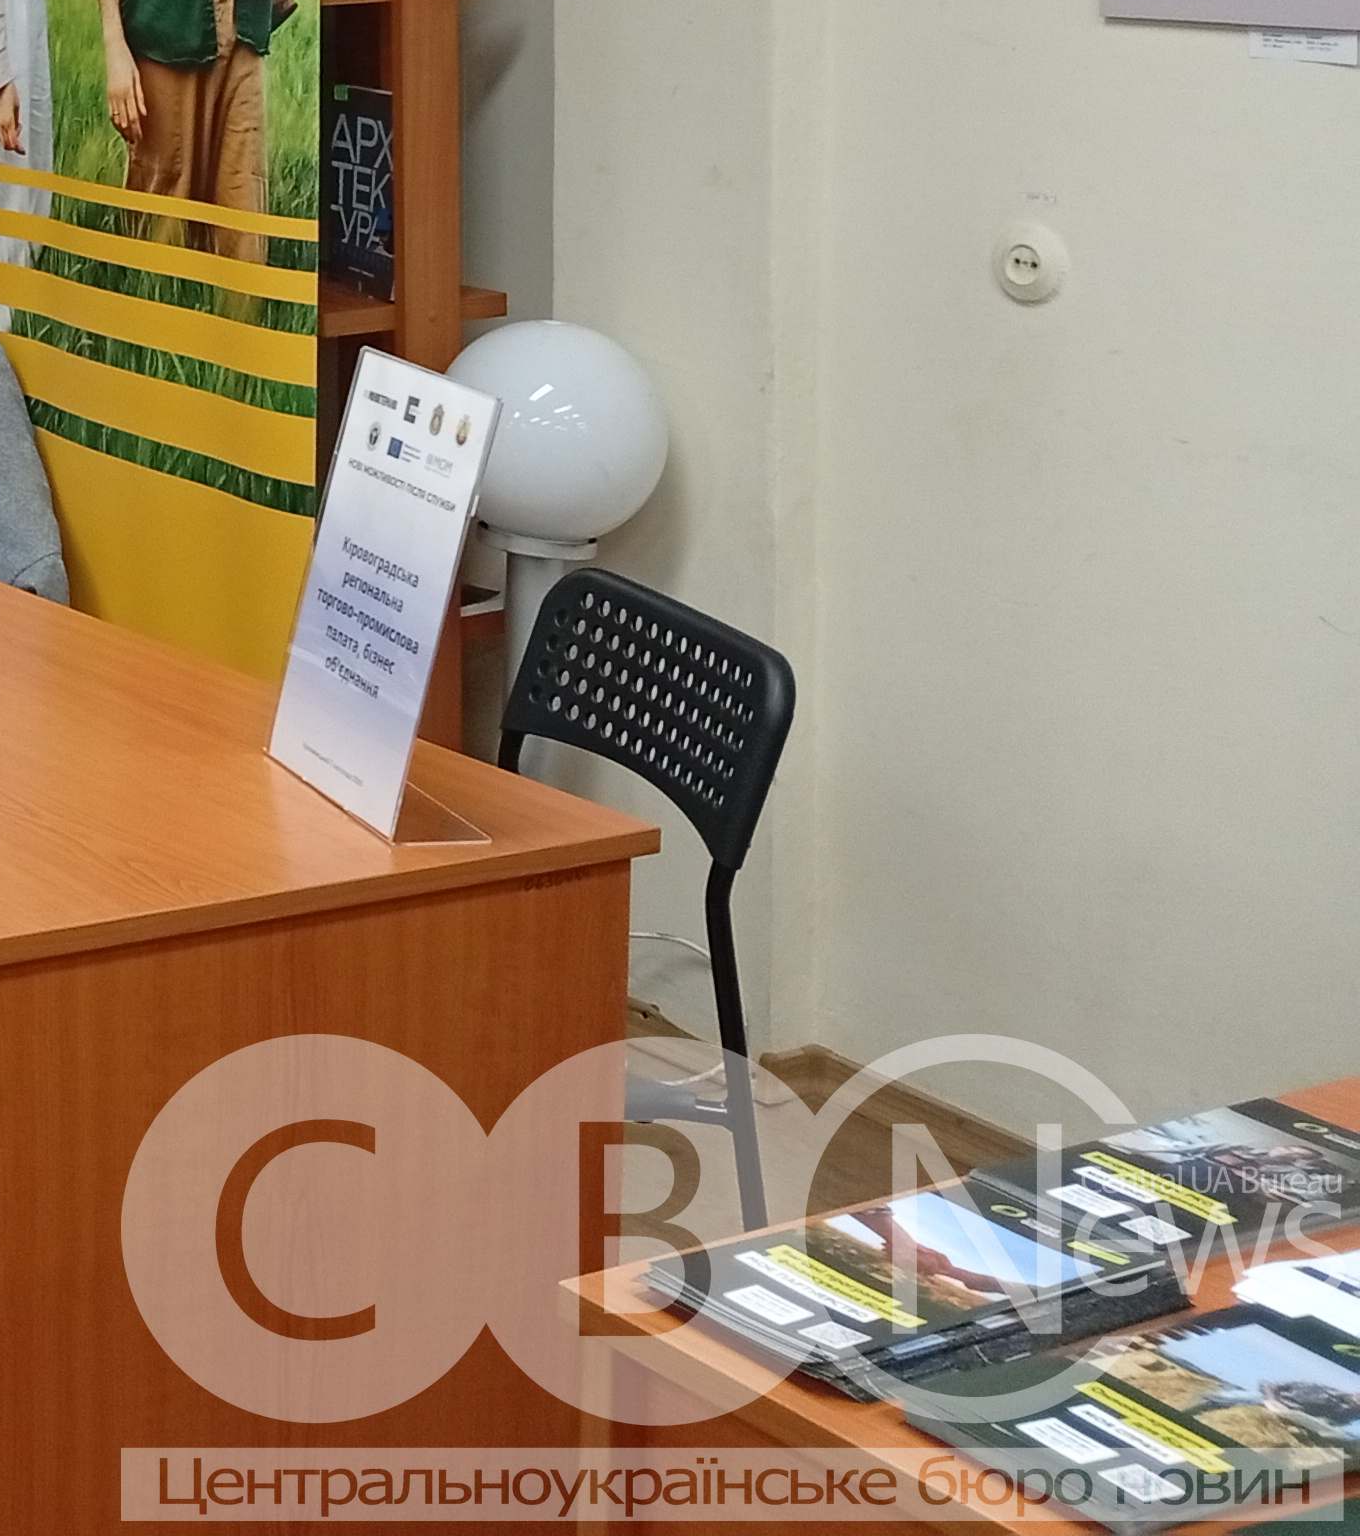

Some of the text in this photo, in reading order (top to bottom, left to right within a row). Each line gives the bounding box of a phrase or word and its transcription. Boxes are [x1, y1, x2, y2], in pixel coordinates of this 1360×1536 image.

[331, 160, 391, 212] ТЕК
[342, 536, 420, 588] Кіровоградська
[341, 571, 404, 614] регіональна
[317, 587, 420, 655] торгово-промислова
[326, 625, 396, 675] палата, бізнес
